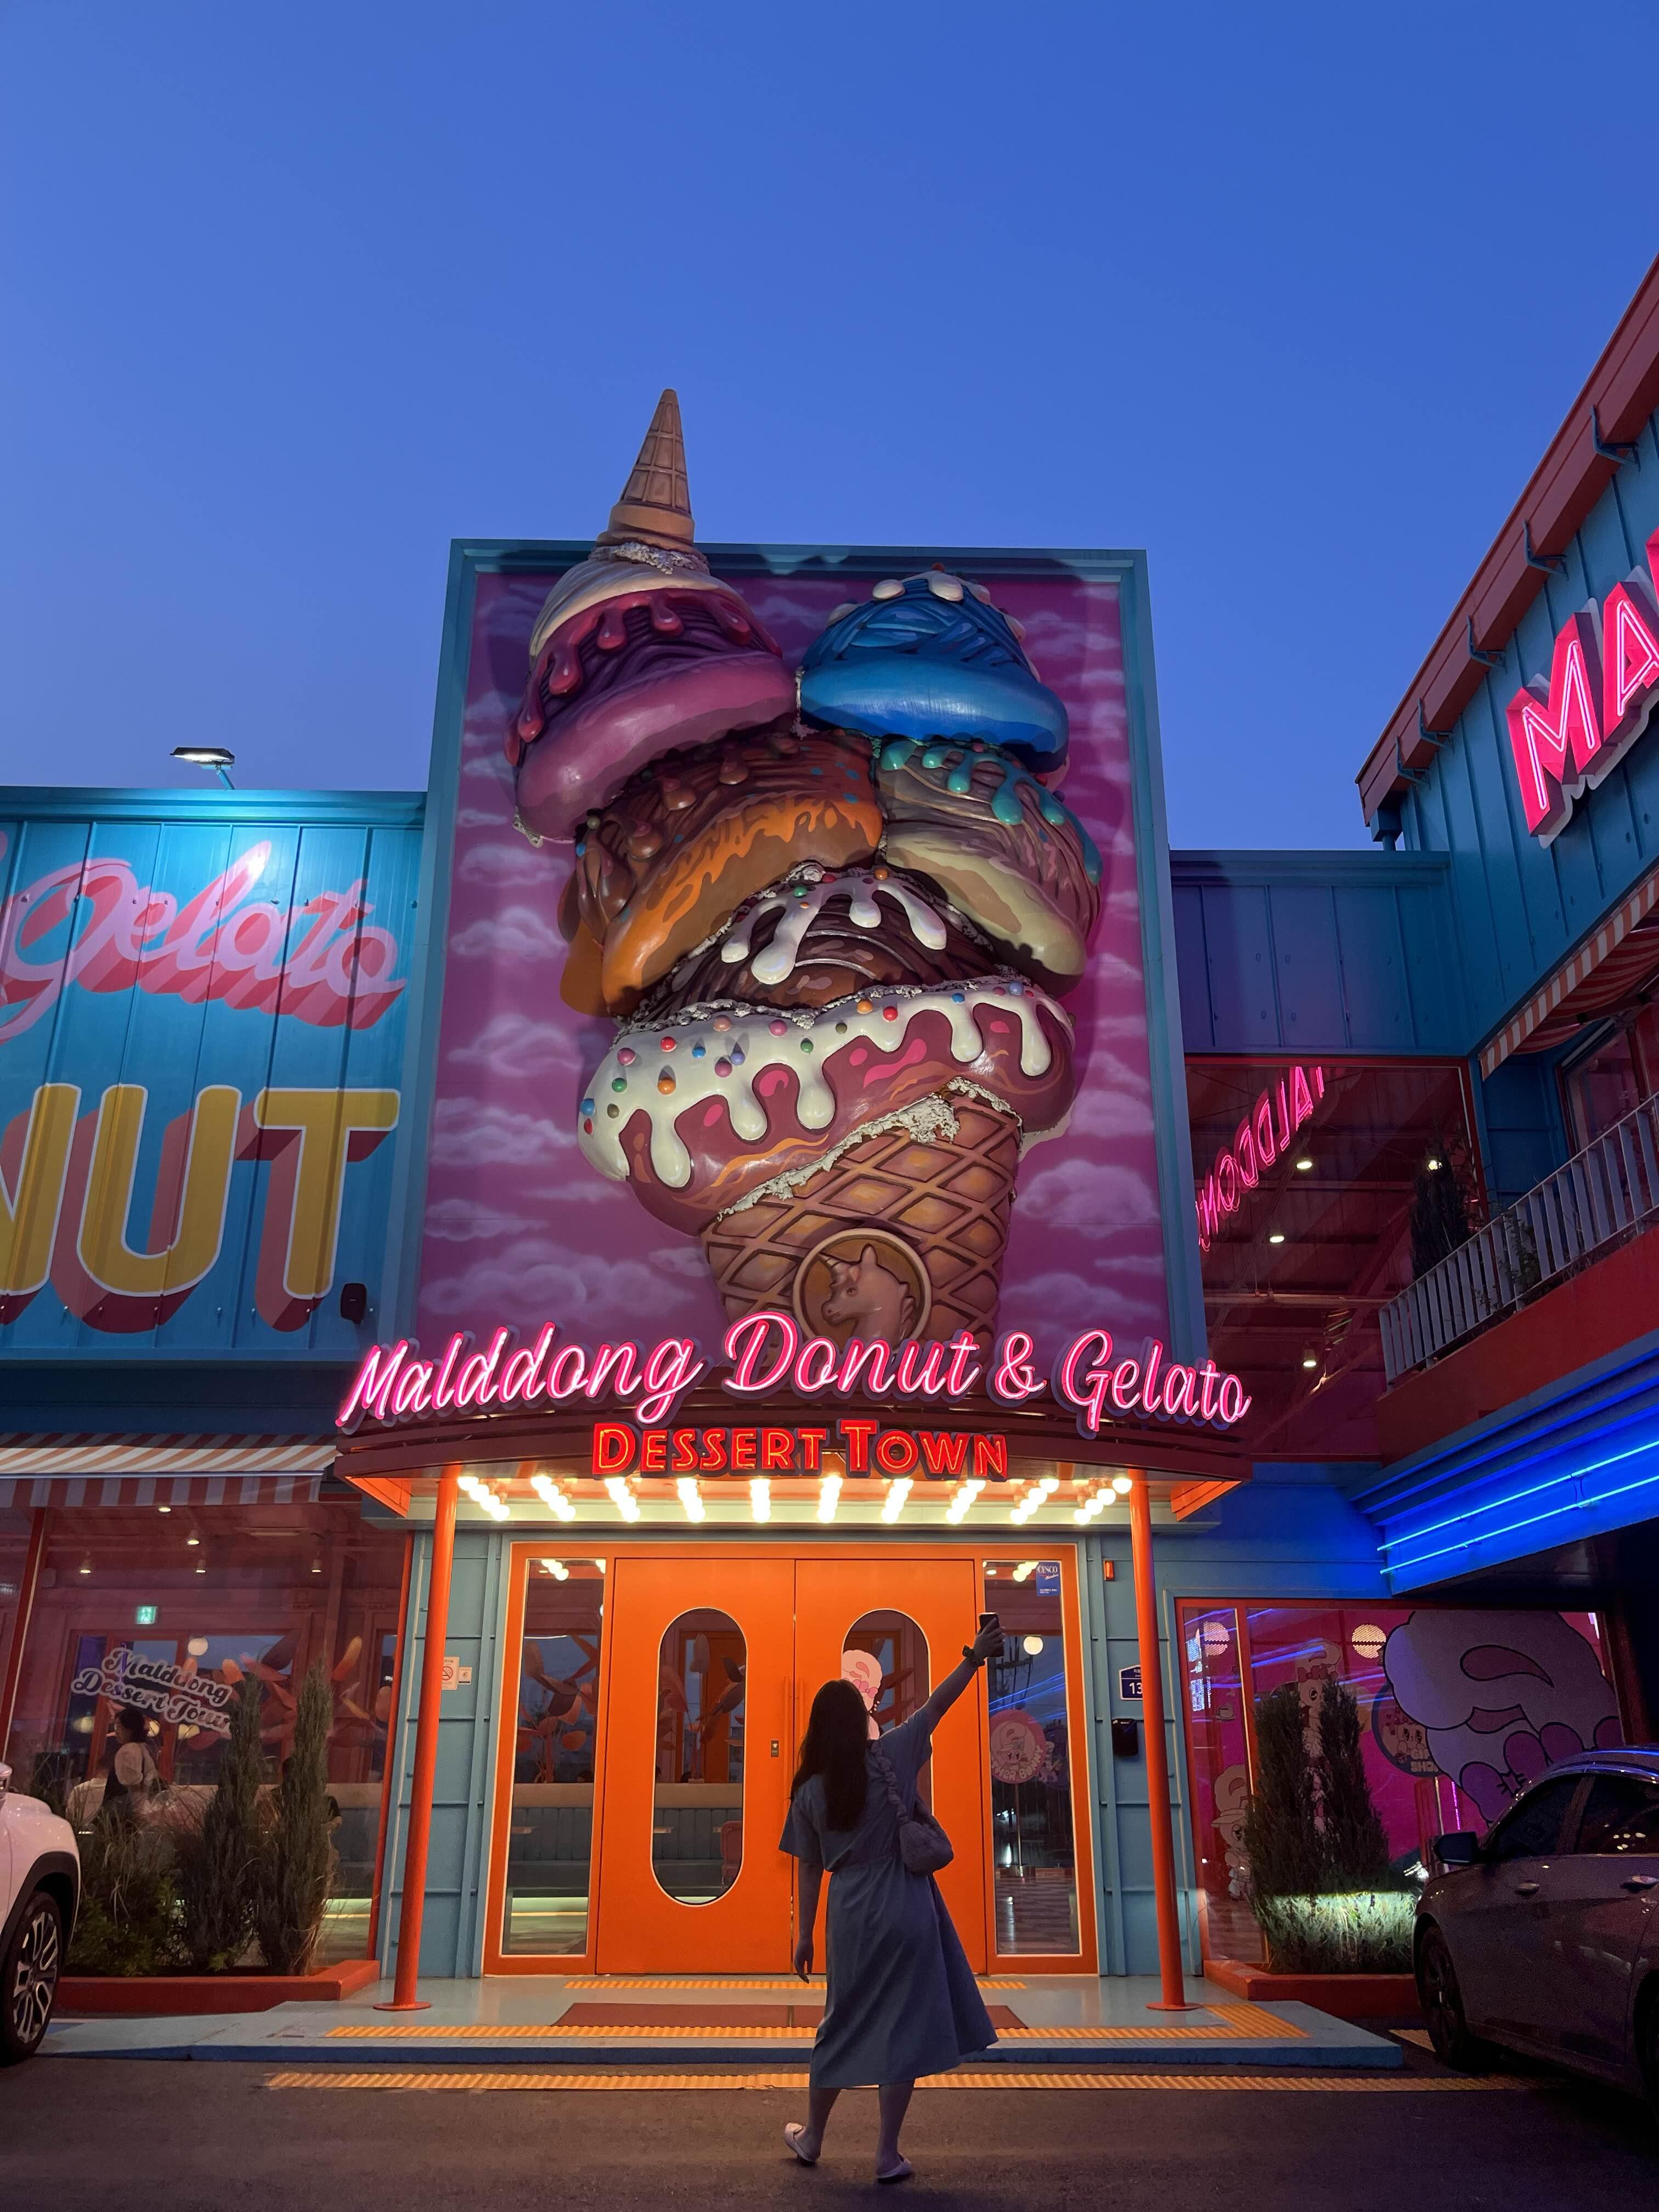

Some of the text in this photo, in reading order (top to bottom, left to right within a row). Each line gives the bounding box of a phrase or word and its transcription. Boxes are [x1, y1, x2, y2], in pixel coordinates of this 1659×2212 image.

[1506, 526, 1659, 836] MA
[0, 840, 407, 1041] Gelato
[335, 1311, 1252, 1432] Malddong Donut & Gelato
[592, 1419, 1008, 1477] DESSERT TOWN
[71, 1668, 169, 1713] Dessert
[102, 1648, 233, 1707] Malddong
